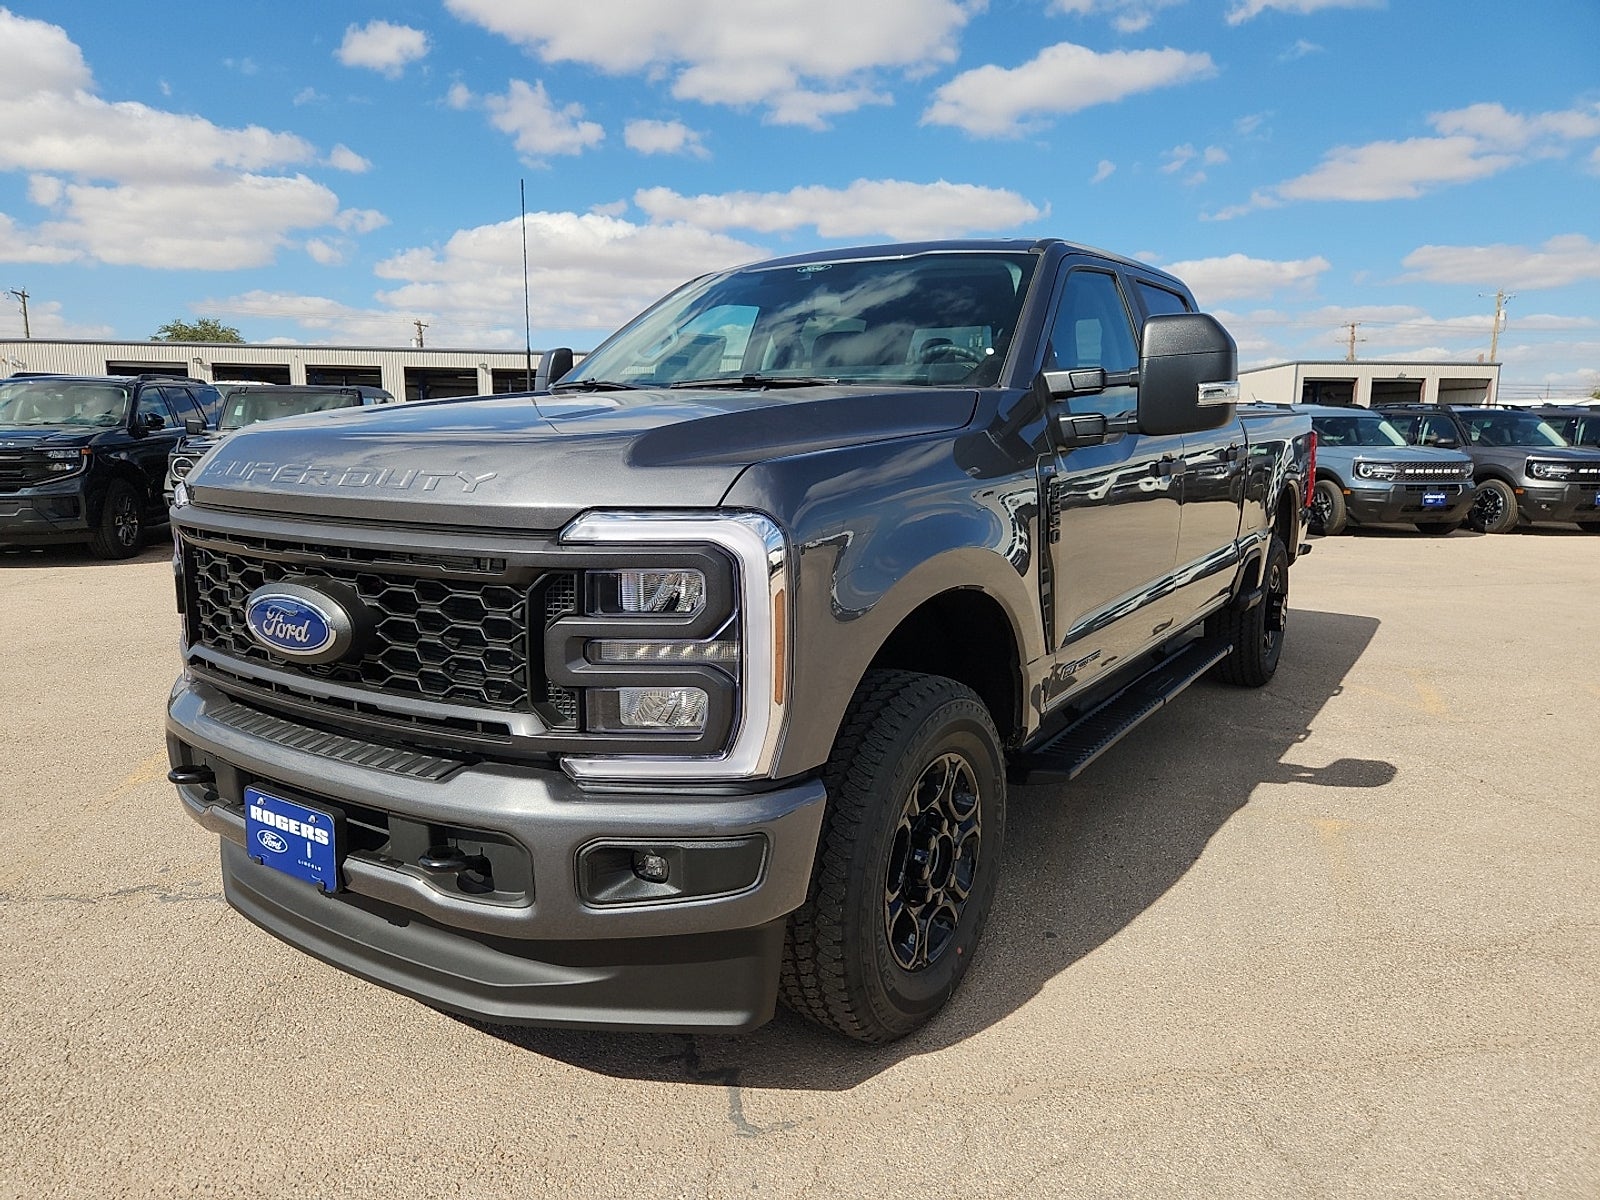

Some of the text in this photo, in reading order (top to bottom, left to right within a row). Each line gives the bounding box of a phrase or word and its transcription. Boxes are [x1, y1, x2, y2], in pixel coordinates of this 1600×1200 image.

[205, 460, 498, 494] SUPER DUTY
[262, 604, 311, 643] Ford
[249, 804, 330, 846] ROGERS
[262, 832, 284, 851] Ford
